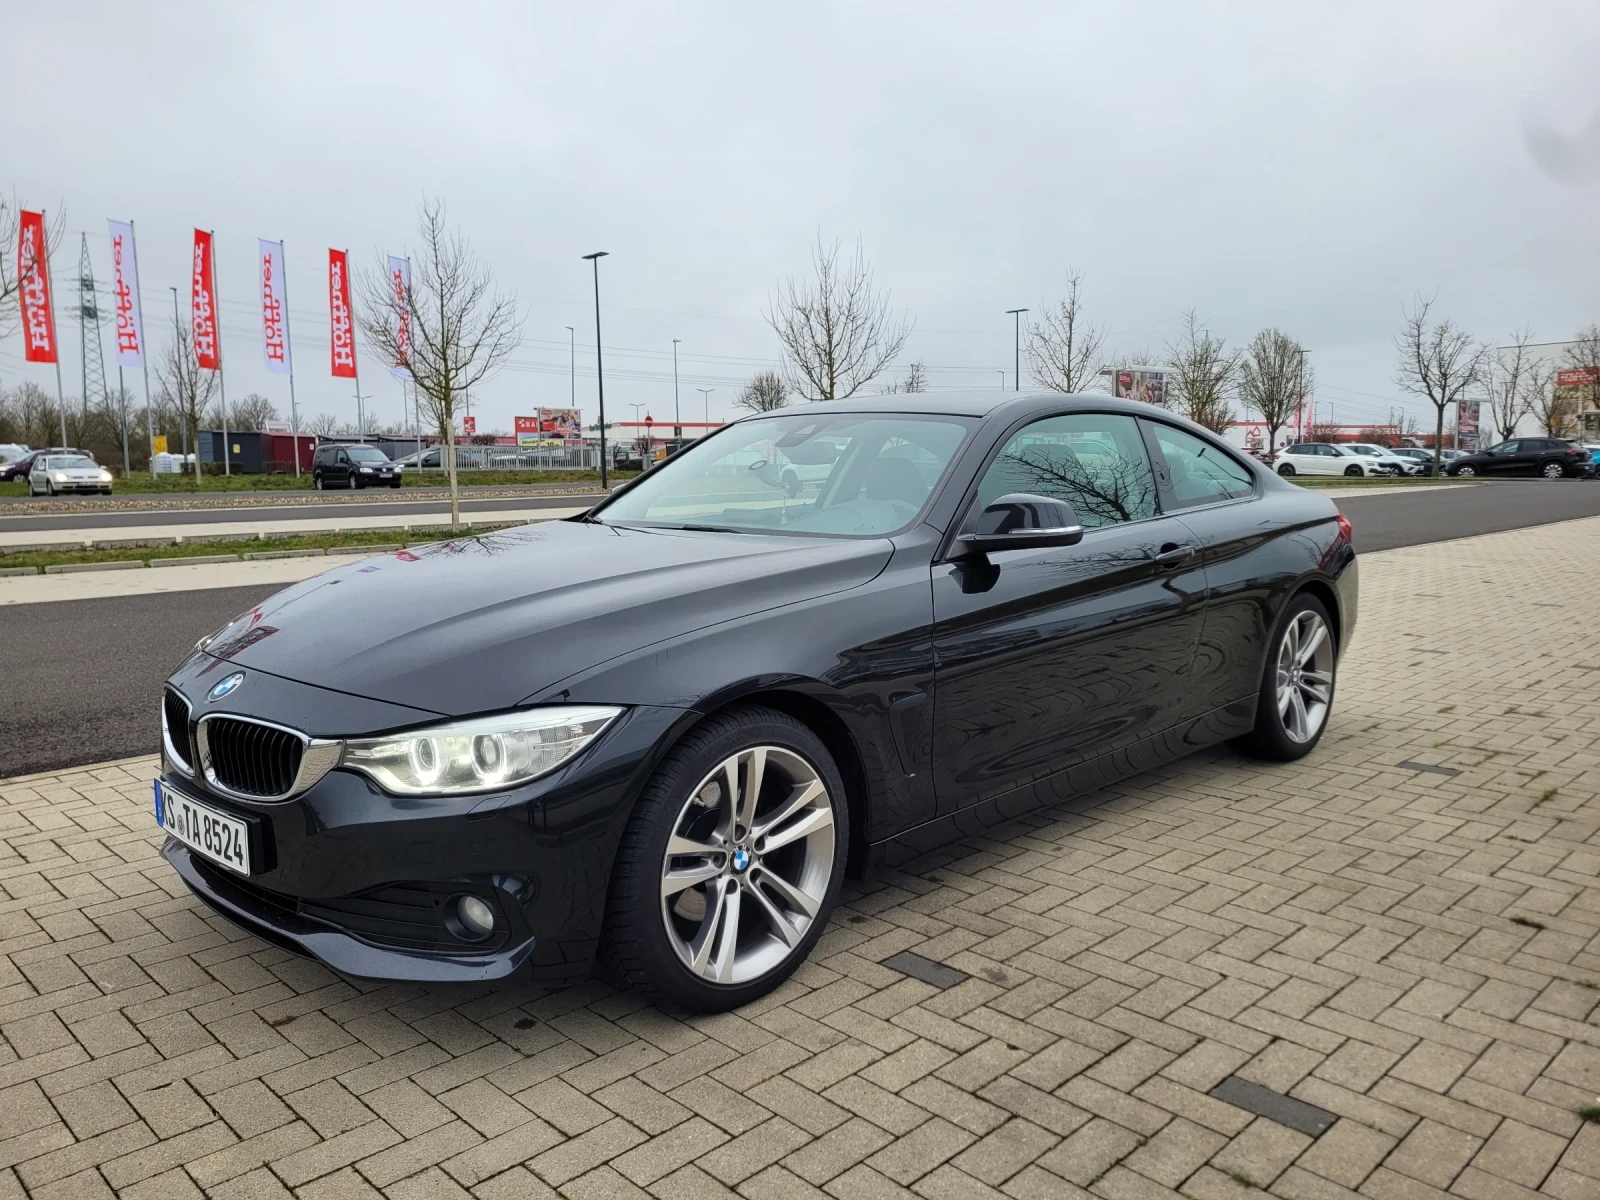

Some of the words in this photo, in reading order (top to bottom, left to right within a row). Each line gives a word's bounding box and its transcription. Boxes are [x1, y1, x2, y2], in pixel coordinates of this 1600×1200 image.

[163, 791, 175, 829] KS
[182, 803, 201, 846] TA
[203, 815, 243, 867] 8524
